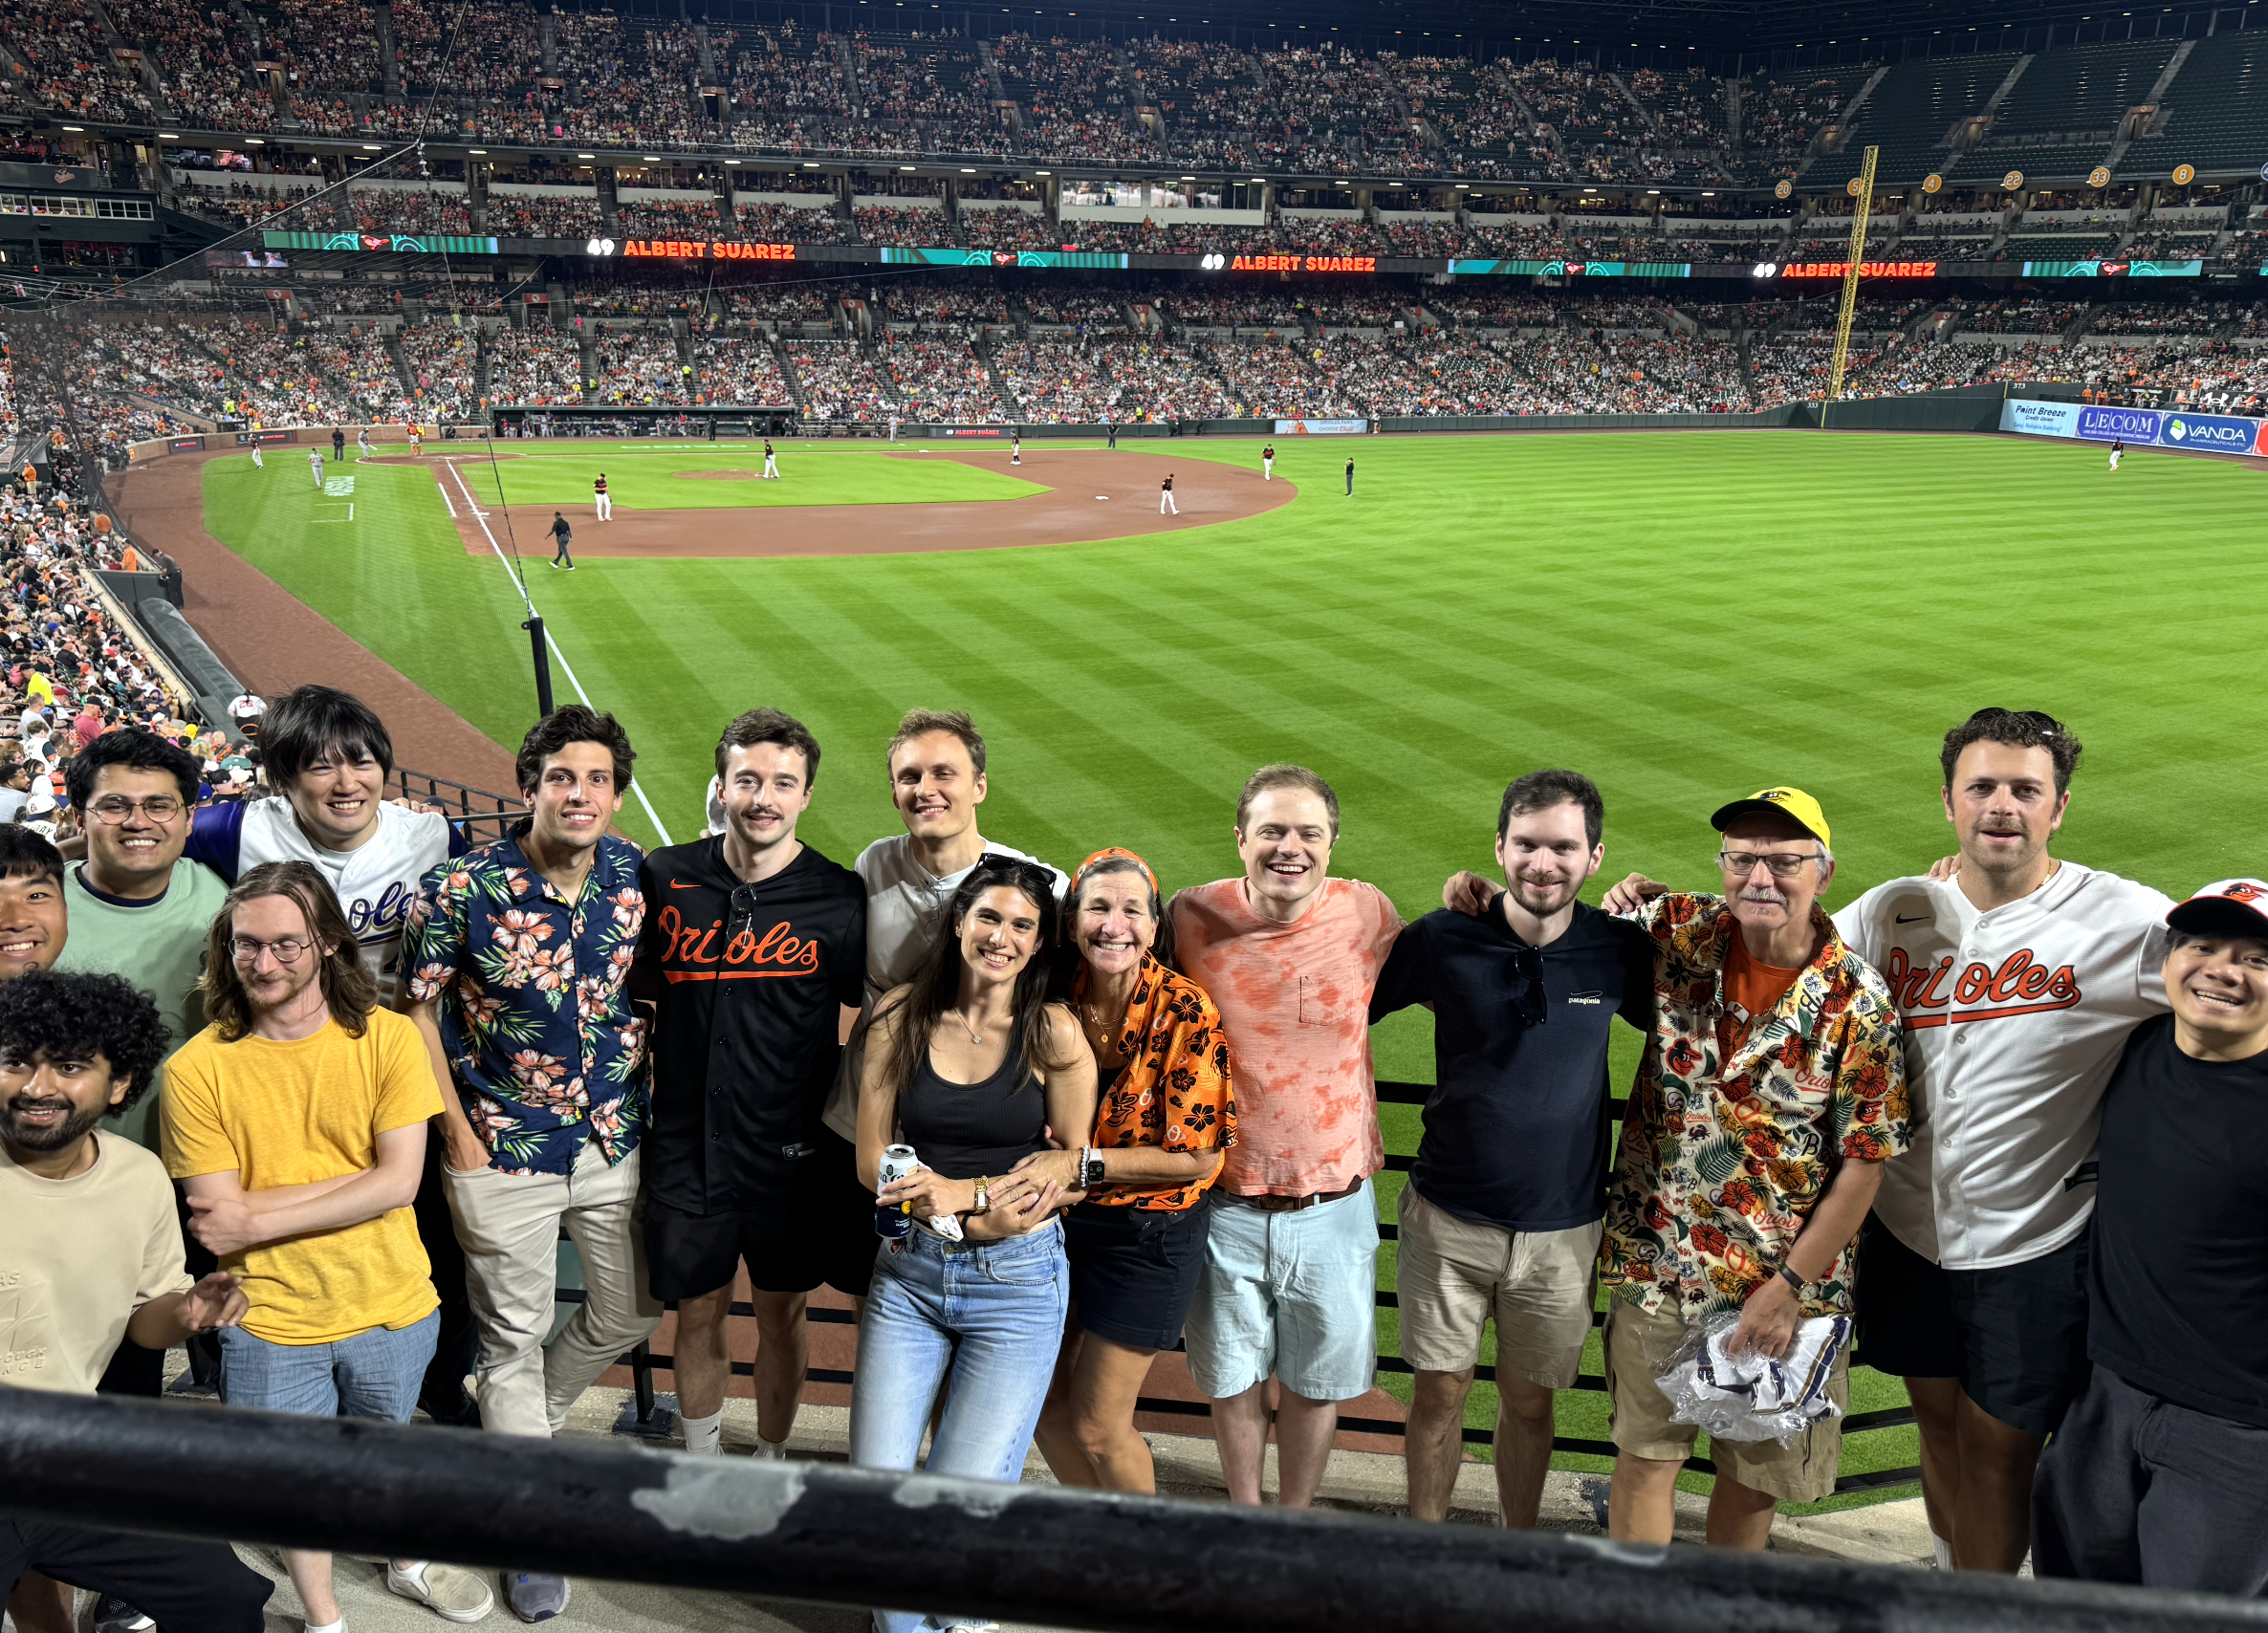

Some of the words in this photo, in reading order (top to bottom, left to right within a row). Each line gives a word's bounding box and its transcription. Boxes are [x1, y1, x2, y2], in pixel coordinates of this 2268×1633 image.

[2006, 175, 2020, 185] 22
[2092, 172, 2107, 183] 33
[2179, 168, 2188, 180] 8
[1777, 185, 1791, 195] 20
[1852, 183, 1859, 192] 5
[1928, 179, 1935, 188] 4
[587, 239, 615, 256] 49
[624, 240, 708, 258] ALBERT
[712, 242, 796, 260] SUAREZ
[1201, 253, 1225, 270] 49
[1232, 255, 1301, 272] ALBERT
[1305, 256, 1376, 272] SUAREZ
[1753, 263, 1776, 278] 49
[1781, 262, 1855, 277] ALBERT
[1858, 262, 1937, 276] SUAREZ
[2038, 406, 2066, 417] Breeze
[2084, 411, 2154, 433] LECOM
[2189, 425, 2246, 442] VANDA
[2190, 438, 2236, 446] PHARMACEUTICALS
[658, 904, 818, 967] Orioles
[1886, 947, 2078, 1009] Orioles
[1795, 1066, 1832, 1088] Orio
